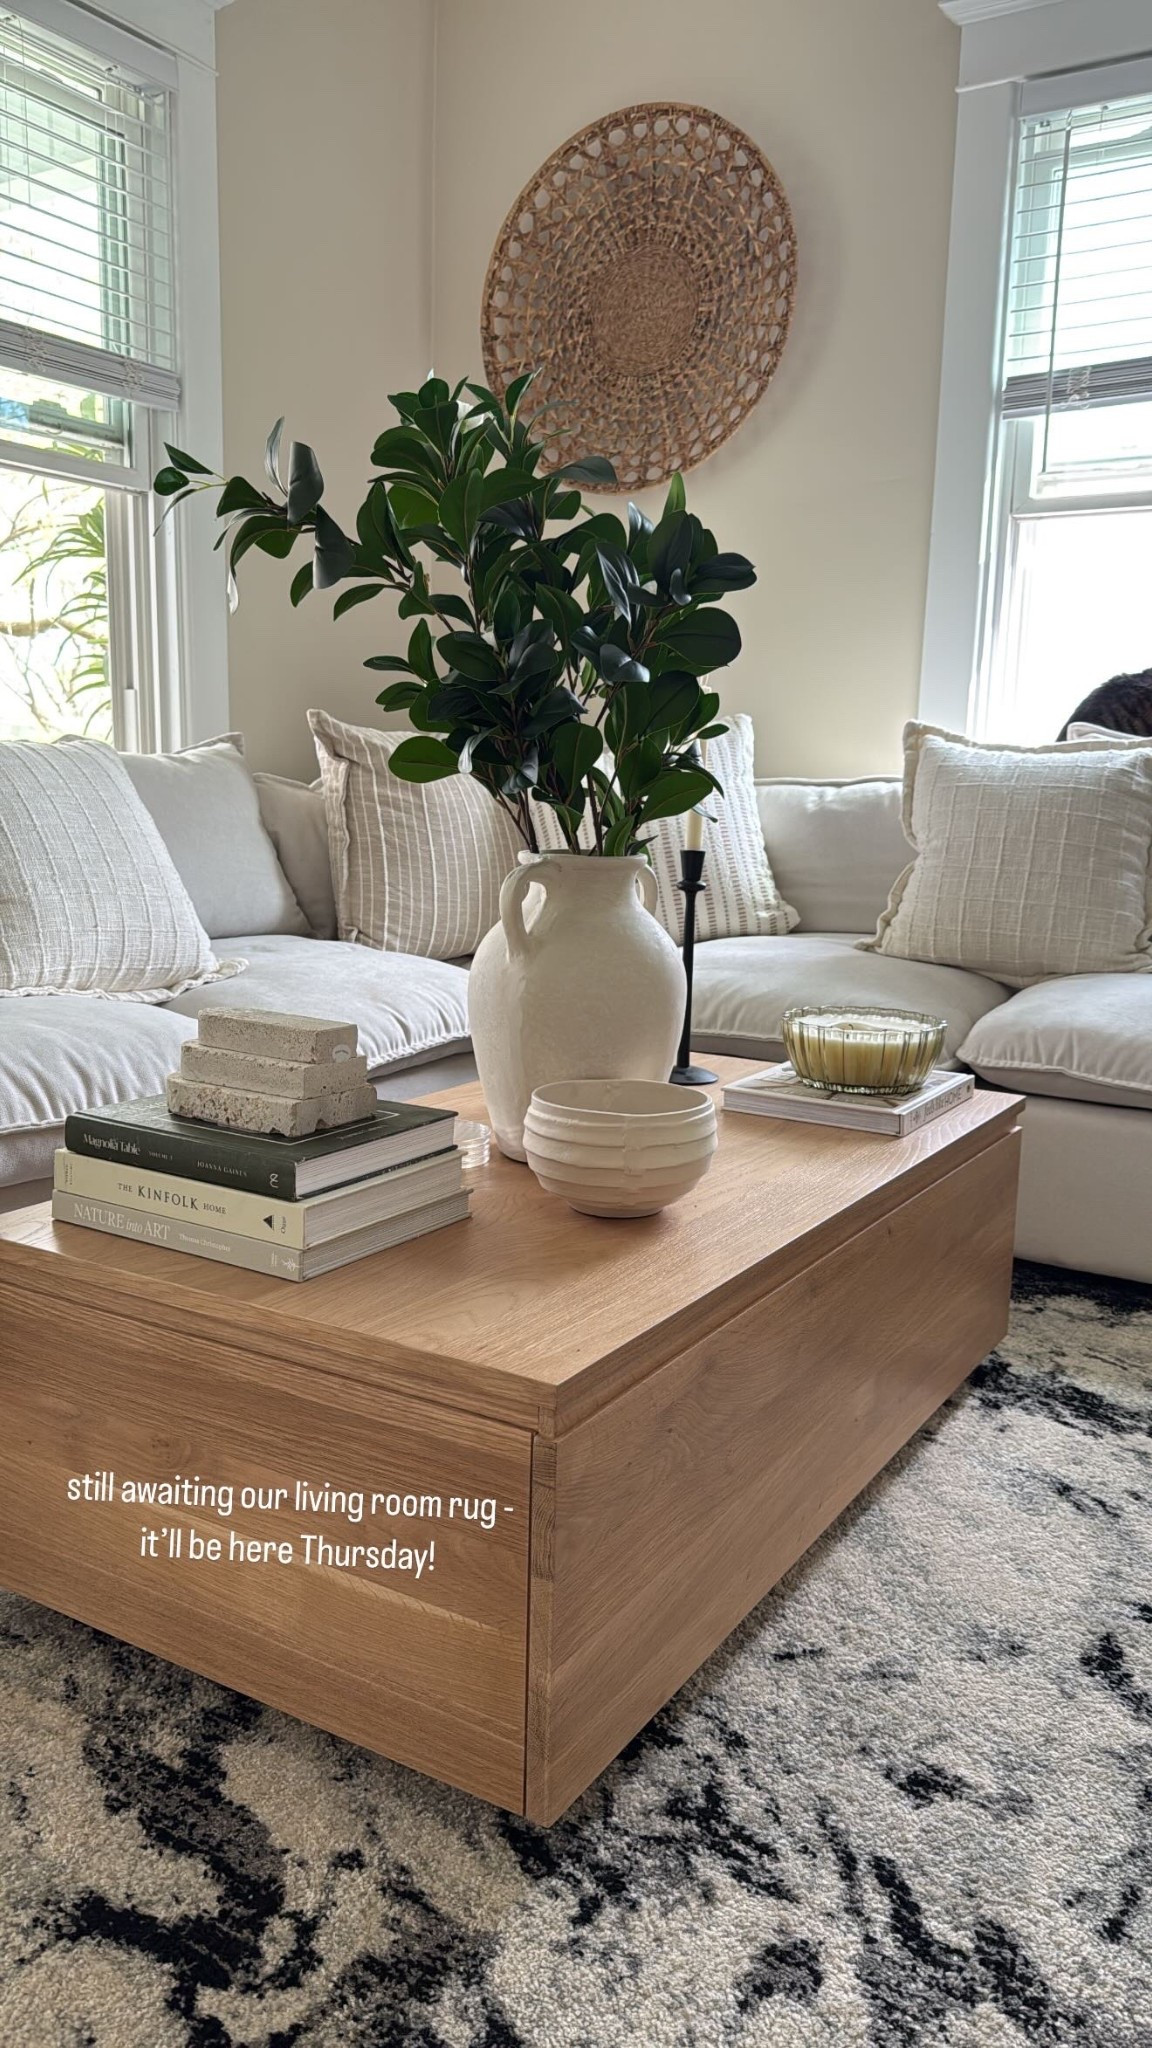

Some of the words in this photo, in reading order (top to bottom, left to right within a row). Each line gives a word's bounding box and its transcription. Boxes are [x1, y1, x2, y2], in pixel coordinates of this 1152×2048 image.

[944, 1086, 961, 1107] HOME
[83, 1133, 119, 1151] Magnolia
[120, 1141, 141, 1155] Table
[197, 1160, 221, 1172] JOANNA
[223, 1166, 248, 1178] GAINES
[117, 1182, 133, 1193] THE
[138, 1185, 199, 1211] KINFOLK
[203, 1202, 227, 1215] HOME
[73, 1202, 125, 1229] NATURE
[126, 1218, 143, 1234] into
[143, 1220, 170, 1241] ART
[179, 1233, 200, 1245] Thomas
[200, 1239, 231, 1253] Christopher
